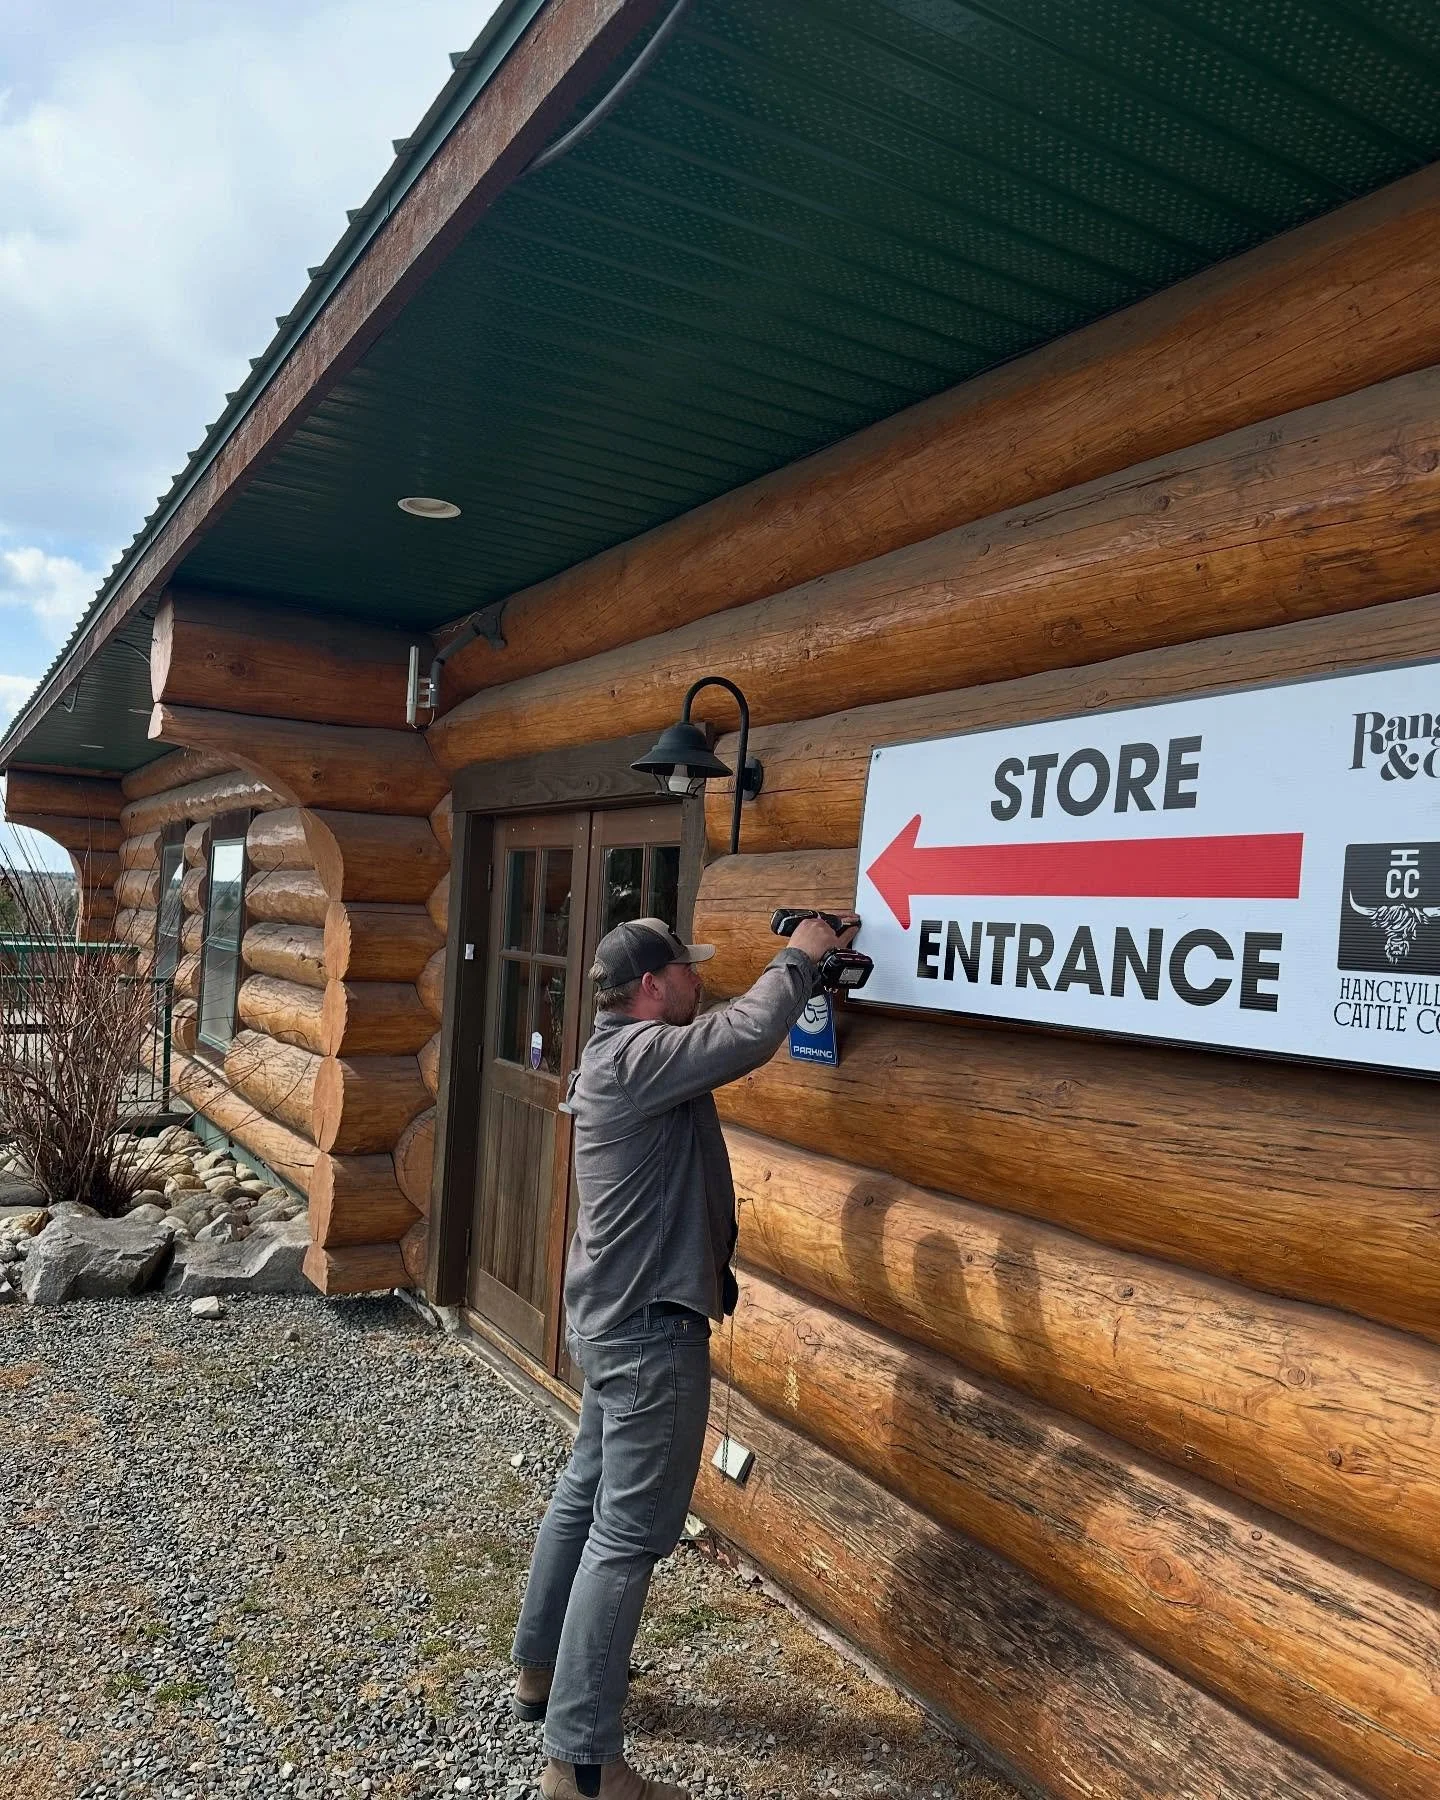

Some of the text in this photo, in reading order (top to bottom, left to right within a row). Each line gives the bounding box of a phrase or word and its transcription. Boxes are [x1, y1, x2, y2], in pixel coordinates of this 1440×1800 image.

[990, 735, 1203, 821] STORE
[1380, 743, 1420, 781] &
[1385, 868, 1420, 899] CC
[916, 919, 1283, 1013] ENTRANCE
[1333, 1002, 1408, 1032] CATTLE
[793, 1045, 833, 1058] PARKING
